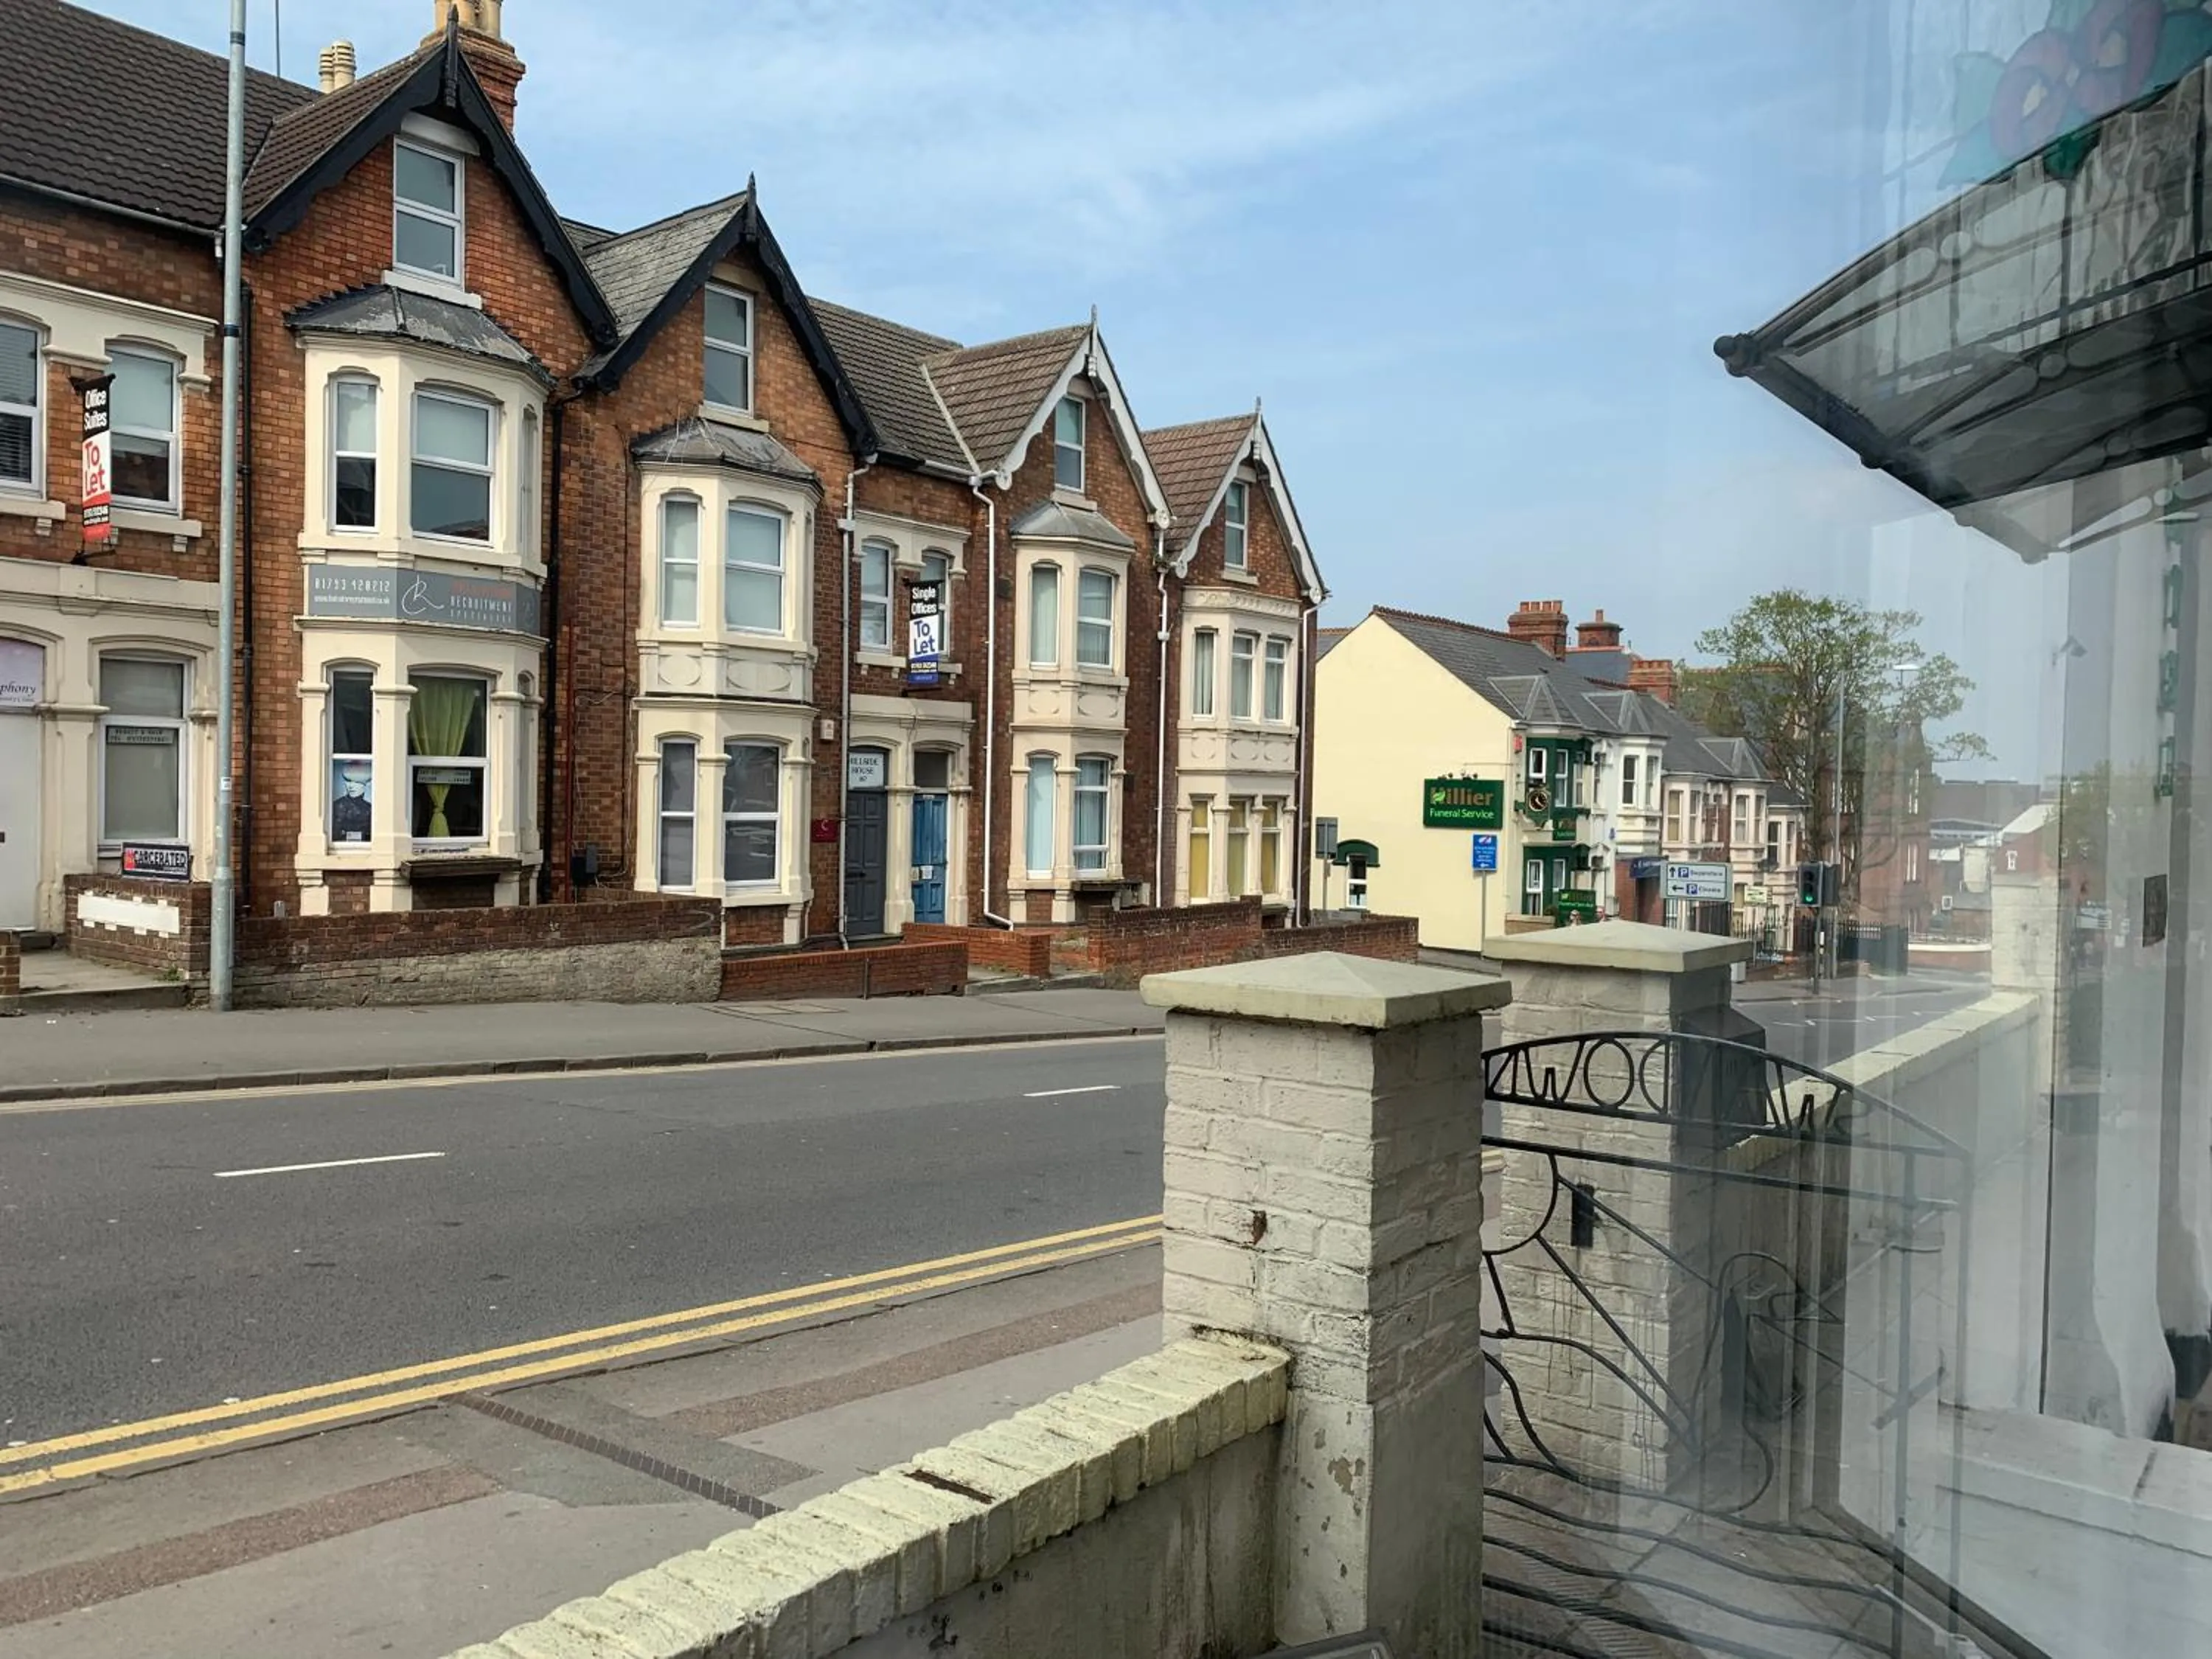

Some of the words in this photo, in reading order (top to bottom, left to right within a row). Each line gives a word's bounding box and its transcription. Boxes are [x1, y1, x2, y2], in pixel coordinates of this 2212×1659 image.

[85, 389, 107, 408] Office
[83, 411, 108, 430] Suites
[84, 441, 100, 468] To
[85, 463, 105, 496] Let
[912, 586, 936, 601] Single
[911, 602, 937, 614] Offices
[913, 620, 930, 637] To
[914, 636, 936, 655] Let
[1430, 787, 1495, 806] Hillier
[1430, 807, 1460, 818] Funeral
[1461, 809, 1494, 819] Service
